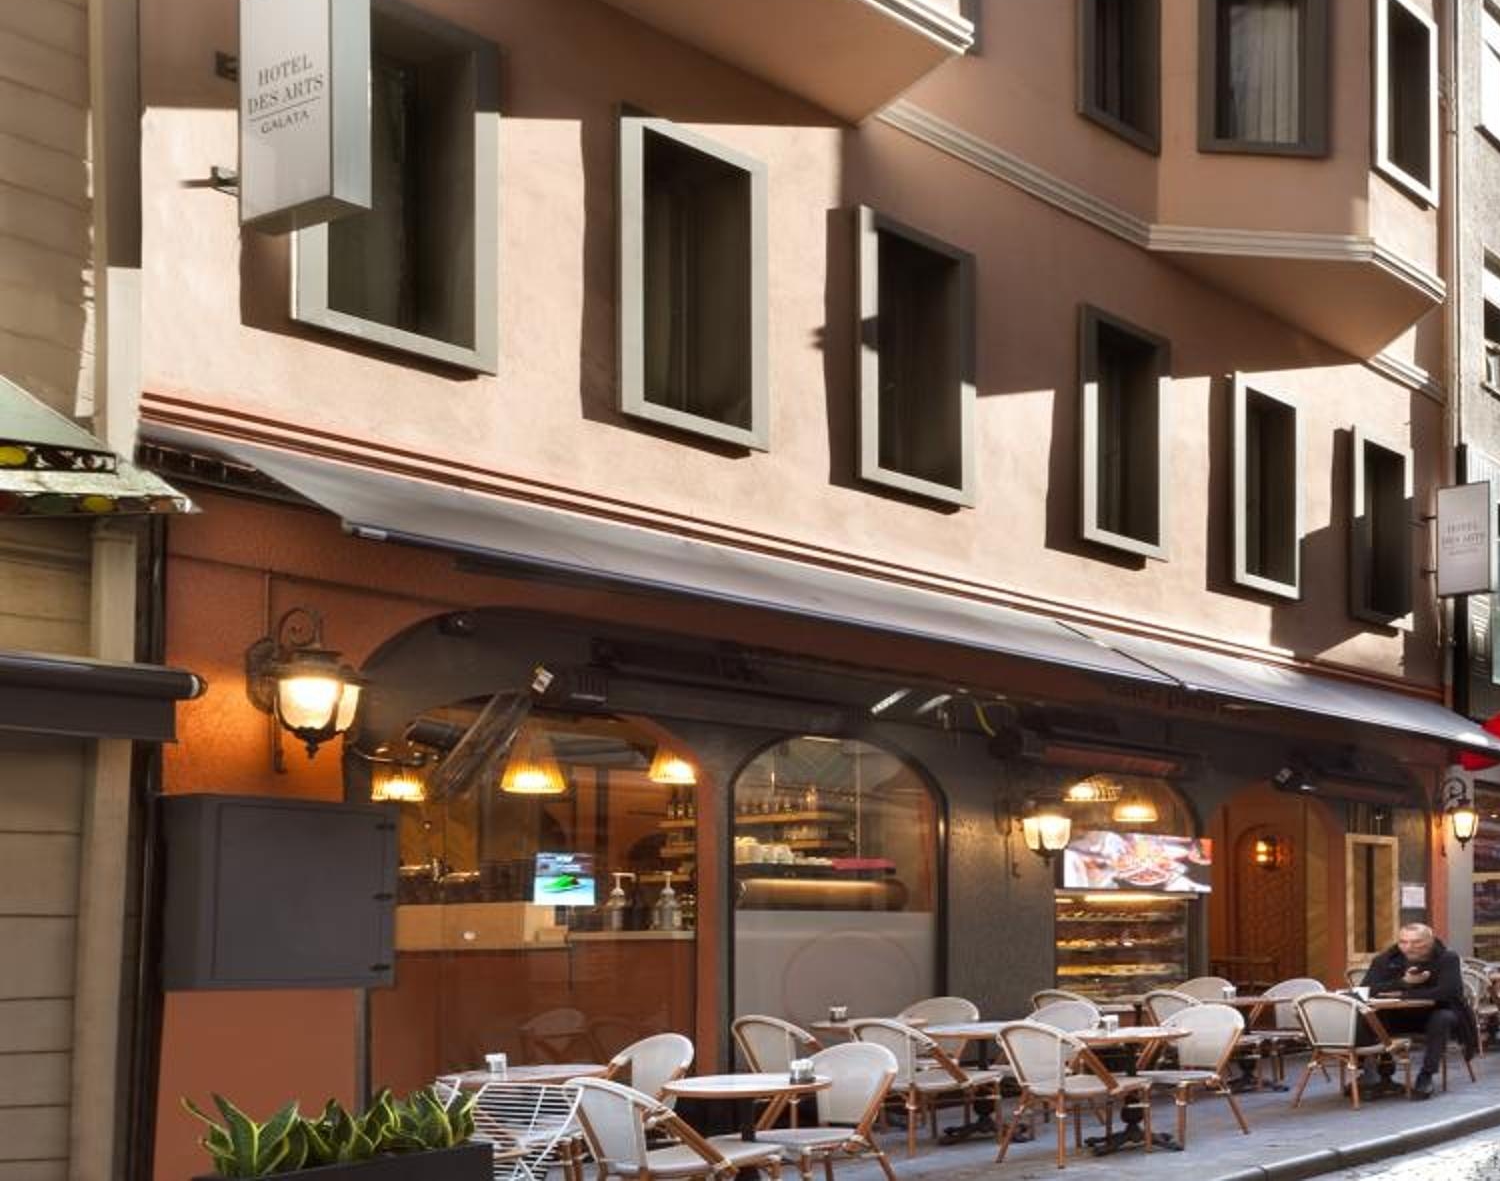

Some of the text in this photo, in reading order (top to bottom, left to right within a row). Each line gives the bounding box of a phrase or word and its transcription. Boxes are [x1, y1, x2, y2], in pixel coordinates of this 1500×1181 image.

[259, 54, 313, 86] HOTEL
[247, 73, 323, 115] DES ARTS
[261, 110, 310, 133] GALATA
